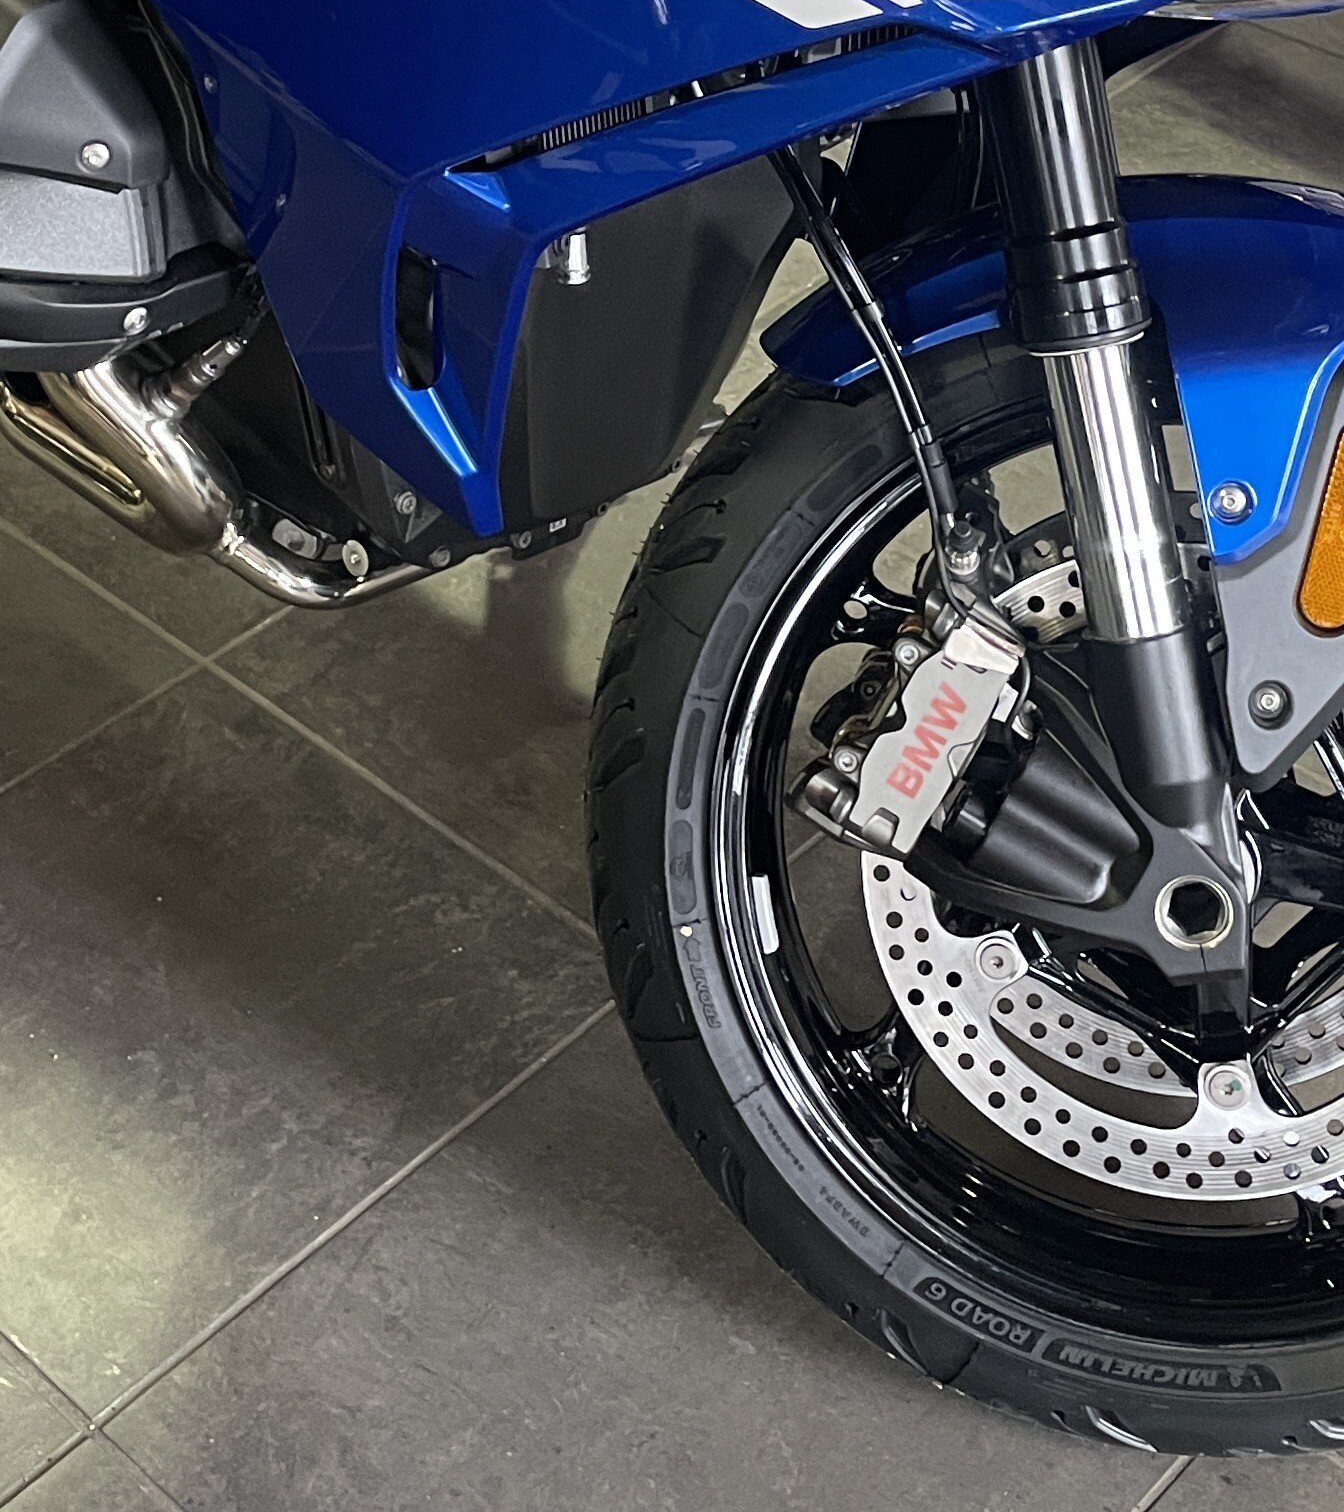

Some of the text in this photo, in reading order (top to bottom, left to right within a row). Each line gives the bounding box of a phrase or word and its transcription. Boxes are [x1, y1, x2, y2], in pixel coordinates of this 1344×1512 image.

[885, 680, 968, 800] BMW
[689, 962, 722, 1029] FRONT
[924, 1281, 1220, 1388] MICHELIN ROAD 6
